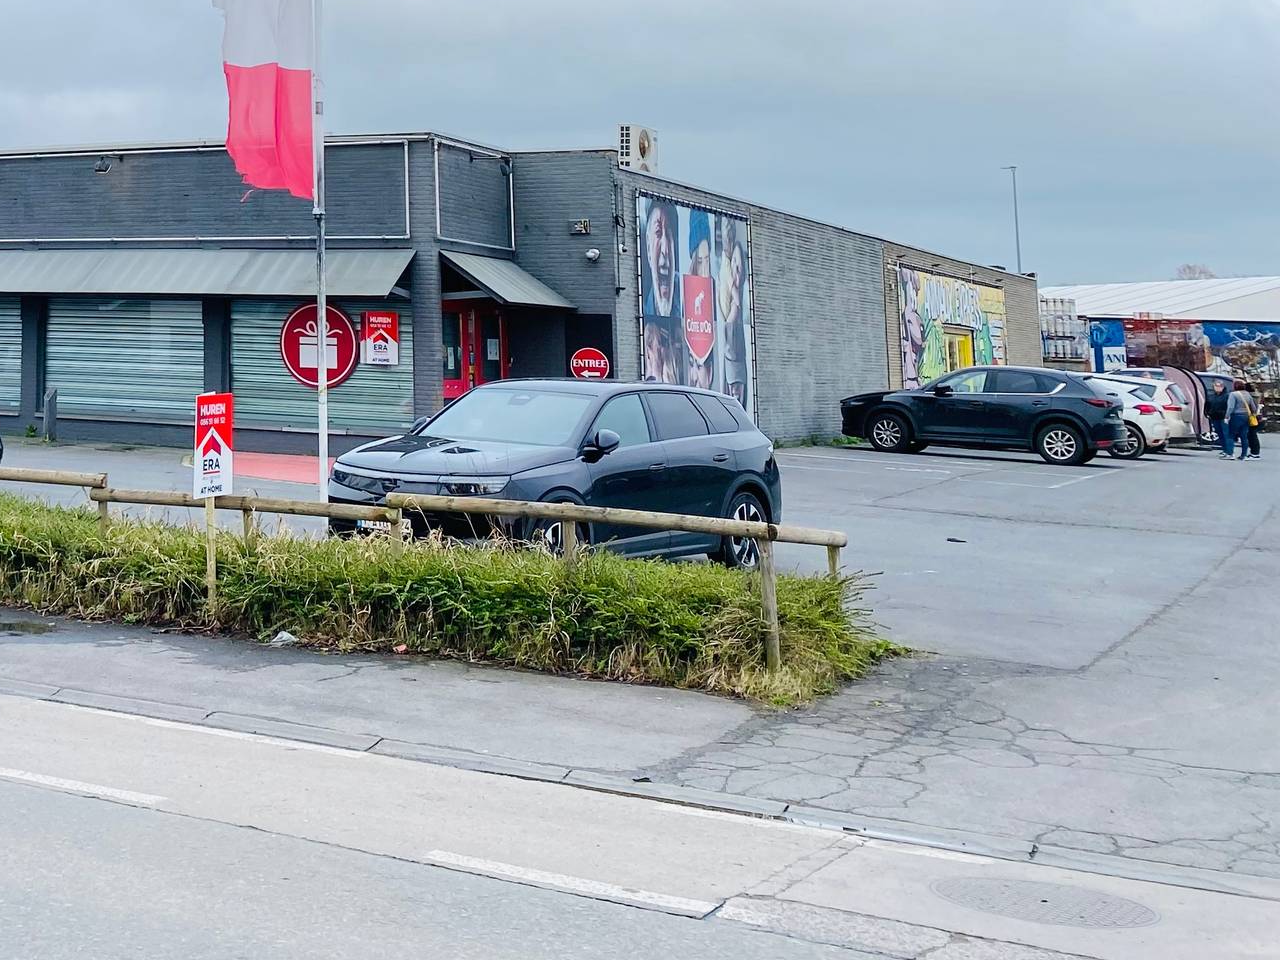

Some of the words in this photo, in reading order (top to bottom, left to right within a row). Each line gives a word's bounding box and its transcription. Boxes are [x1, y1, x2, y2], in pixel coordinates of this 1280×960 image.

[572, 358, 607, 368] ENTREE
[200, 403, 225, 416] HUREN
[203, 458, 220, 471] ERA
[207, 484, 223, 494] HOME
